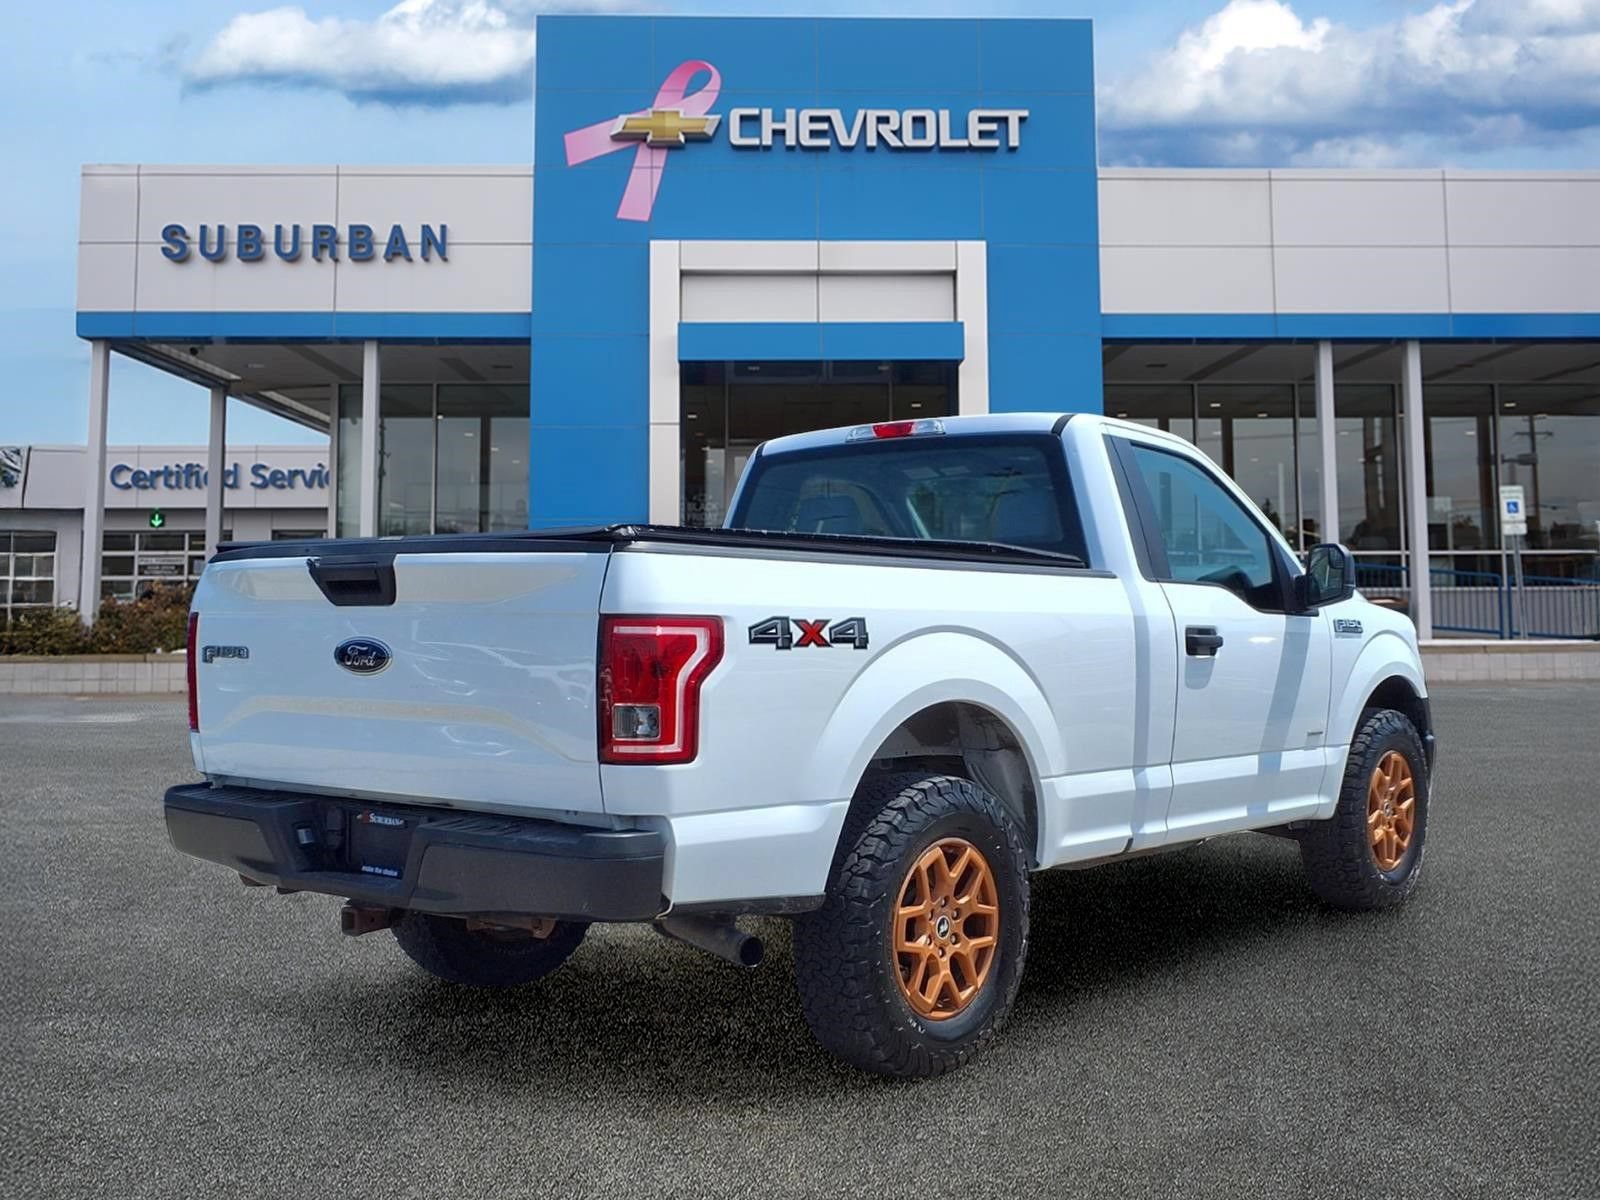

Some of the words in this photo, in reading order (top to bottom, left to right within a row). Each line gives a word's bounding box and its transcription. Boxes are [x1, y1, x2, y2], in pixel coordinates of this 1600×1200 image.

[729, 107, 1030, 149] CHEVROLET
[161, 223, 449, 262] SUBURBAN
[110, 463, 240, 490] Certifid
